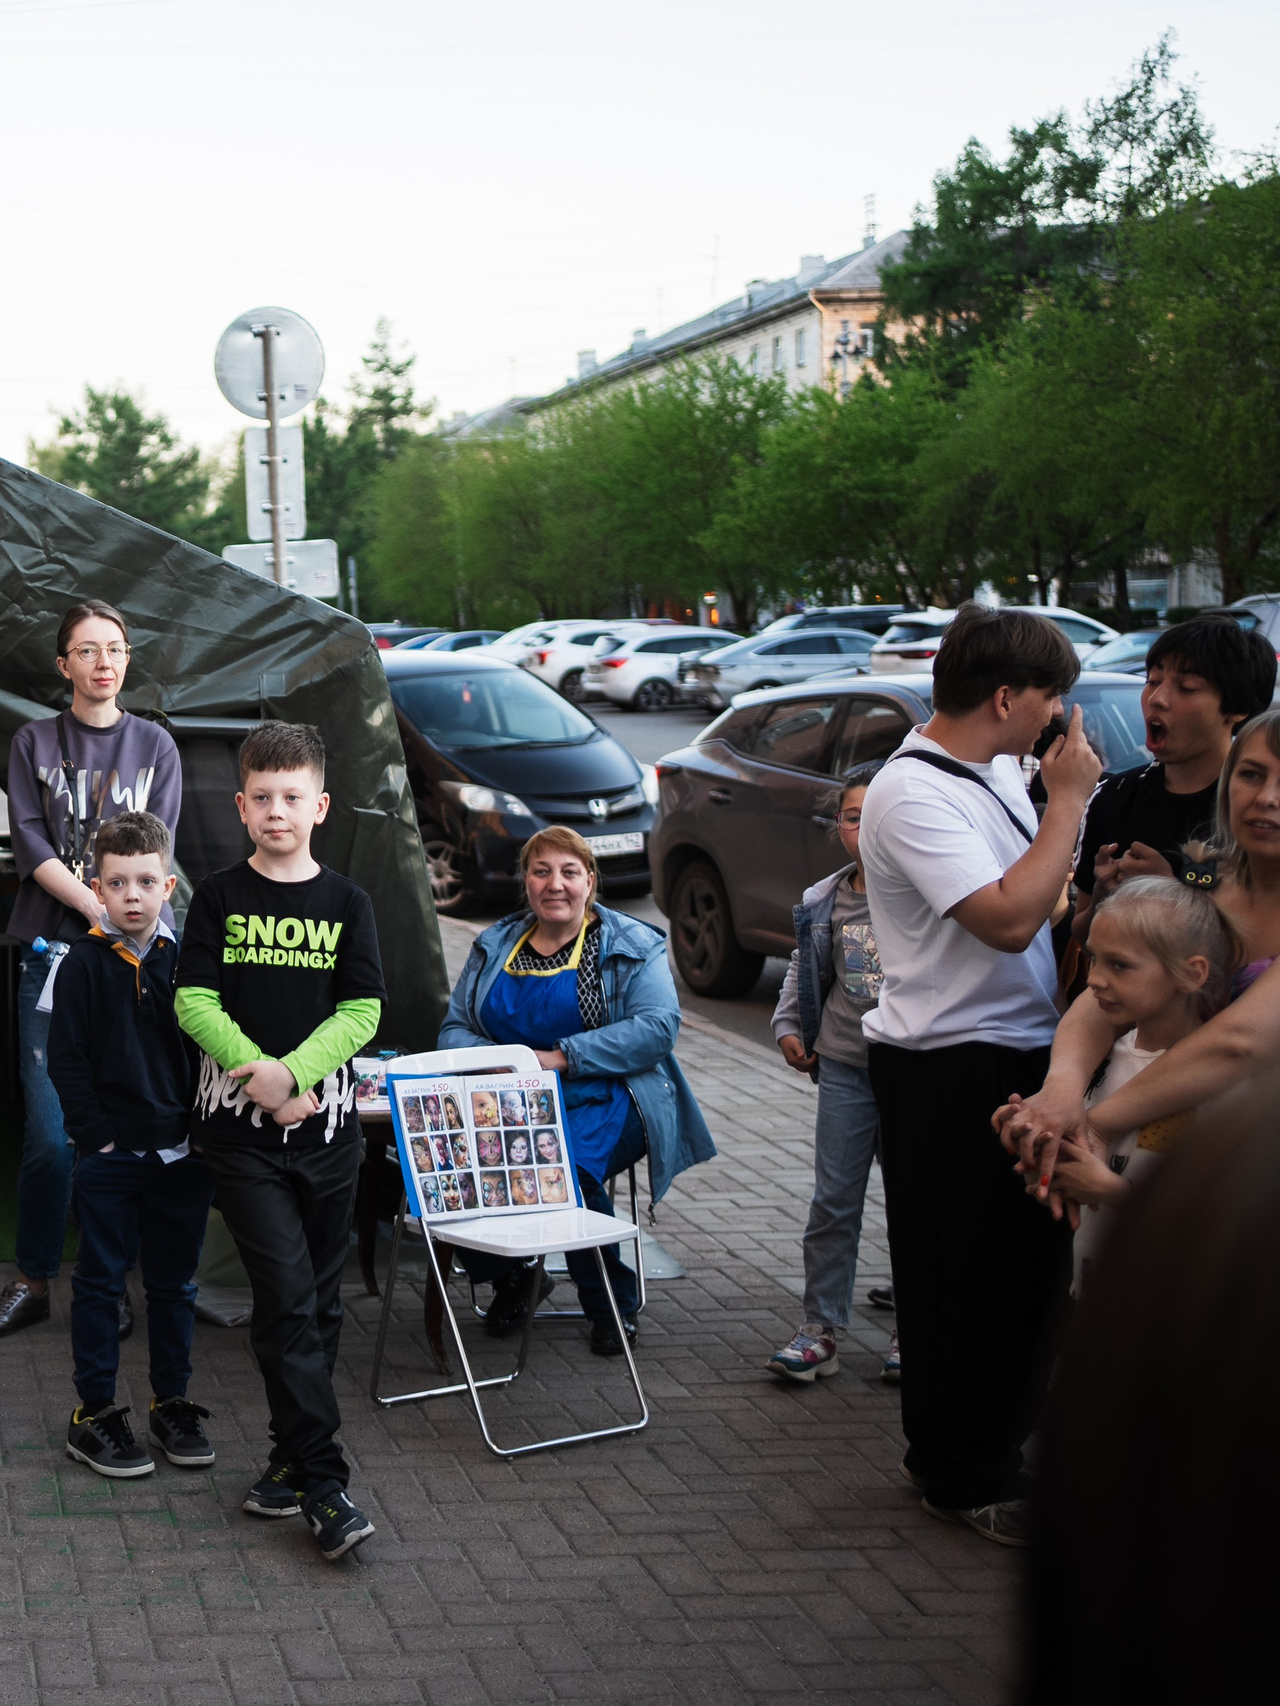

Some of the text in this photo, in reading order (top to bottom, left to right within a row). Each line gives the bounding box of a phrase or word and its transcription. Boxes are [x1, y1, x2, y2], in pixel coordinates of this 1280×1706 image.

[225, 914, 343, 951] SNOW
[432, 1083, 449, 1092] 150
[516, 1079, 540, 1089] 150
